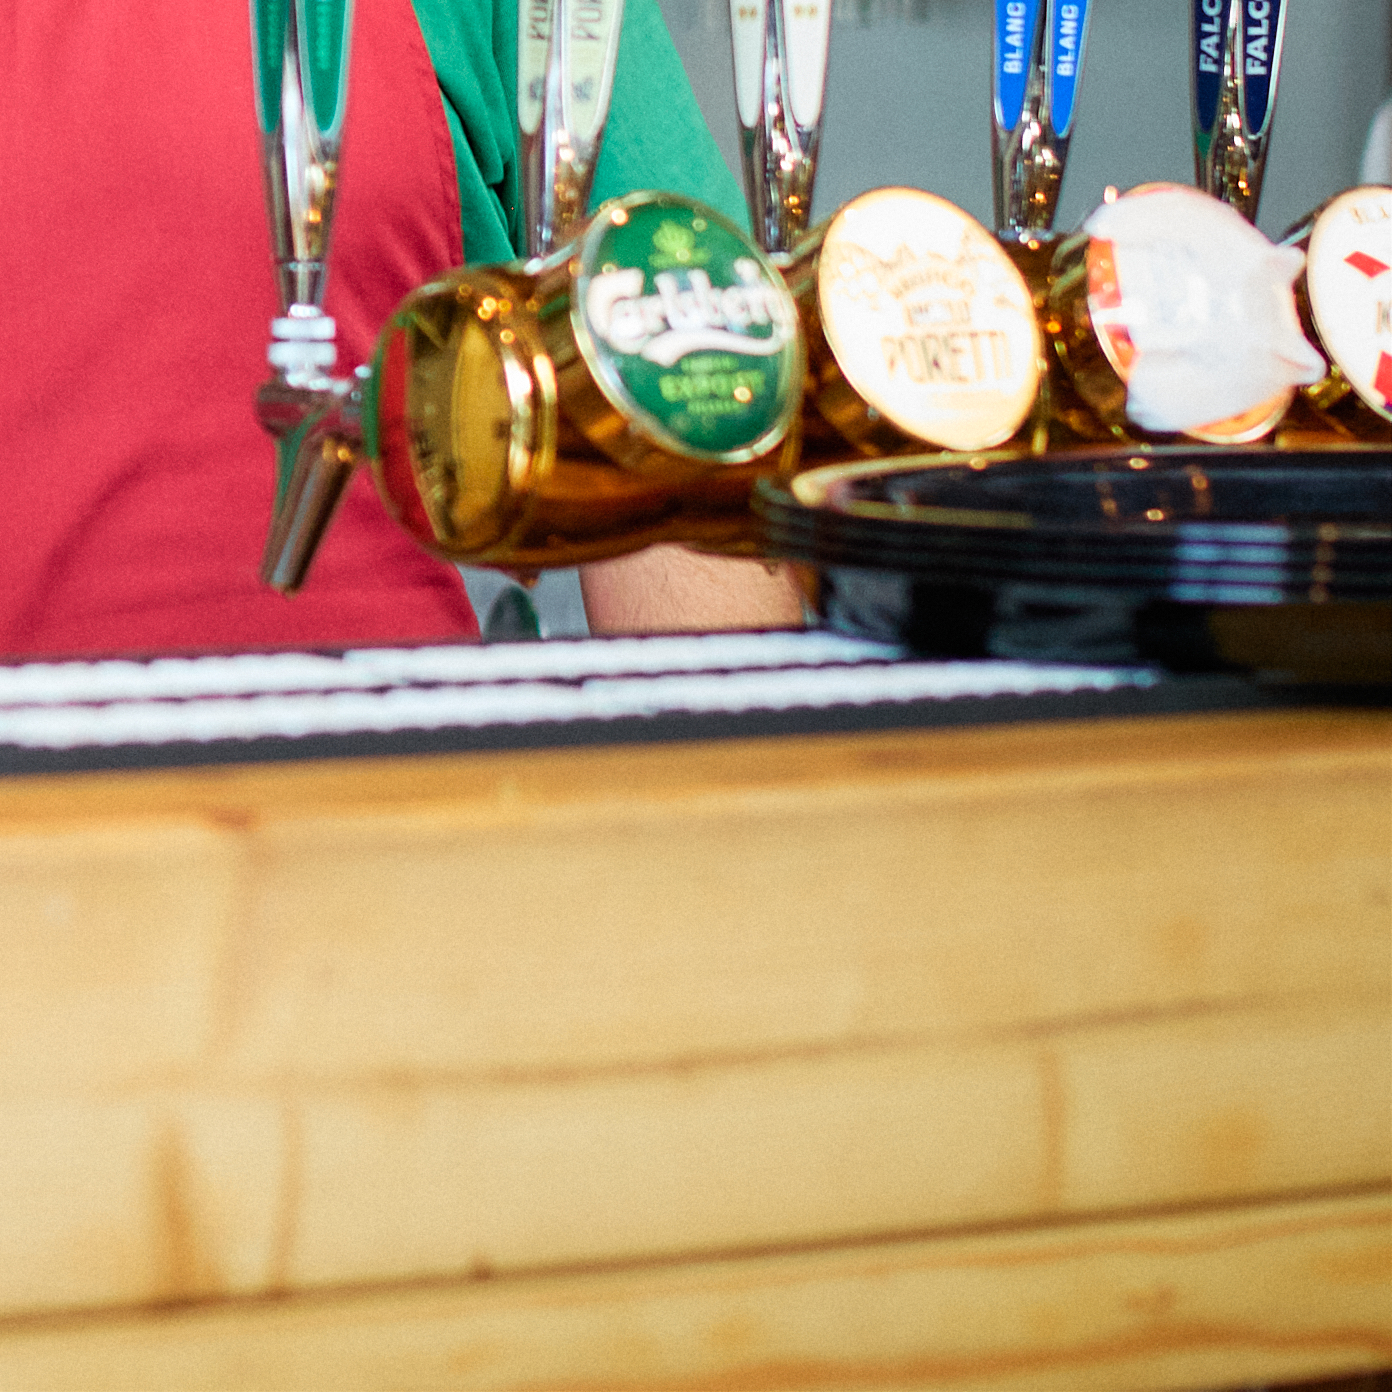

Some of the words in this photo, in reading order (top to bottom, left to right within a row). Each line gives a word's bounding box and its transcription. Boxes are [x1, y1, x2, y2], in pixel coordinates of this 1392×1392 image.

[1003, 1, 1027, 74] BLANC
[1056, 4, 1079, 76] BLANC
[587, 258, 795, 368] Carlsberg
[881, 330, 1014, 384] PORETTI
